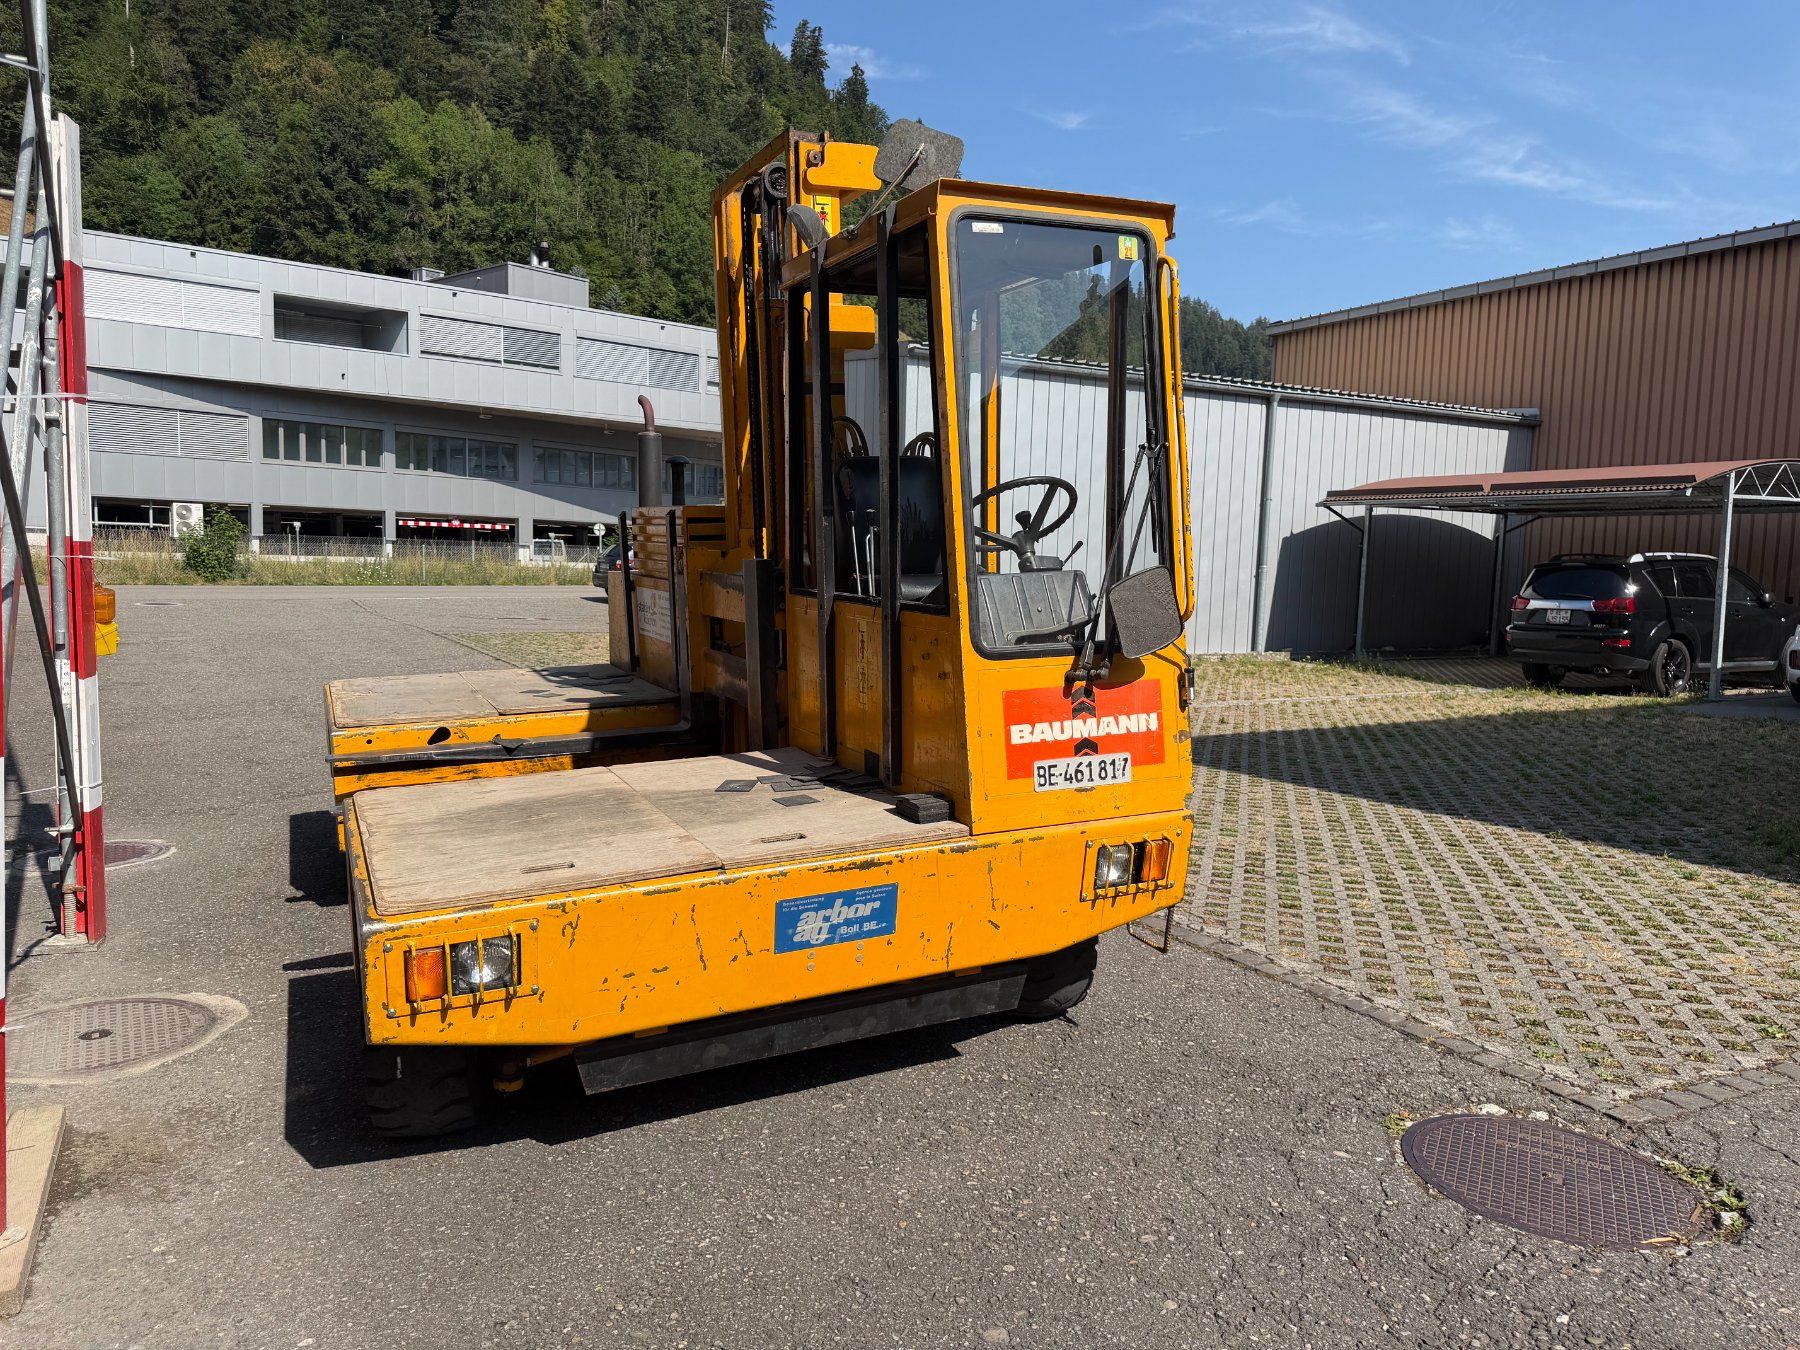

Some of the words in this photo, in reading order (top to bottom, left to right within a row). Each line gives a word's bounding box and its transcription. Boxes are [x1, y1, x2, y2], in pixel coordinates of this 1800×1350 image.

[1010, 712, 1158, 745] BAUMANN
[797, 898, 881, 927] arbor
[793, 922, 831, 944] ag
